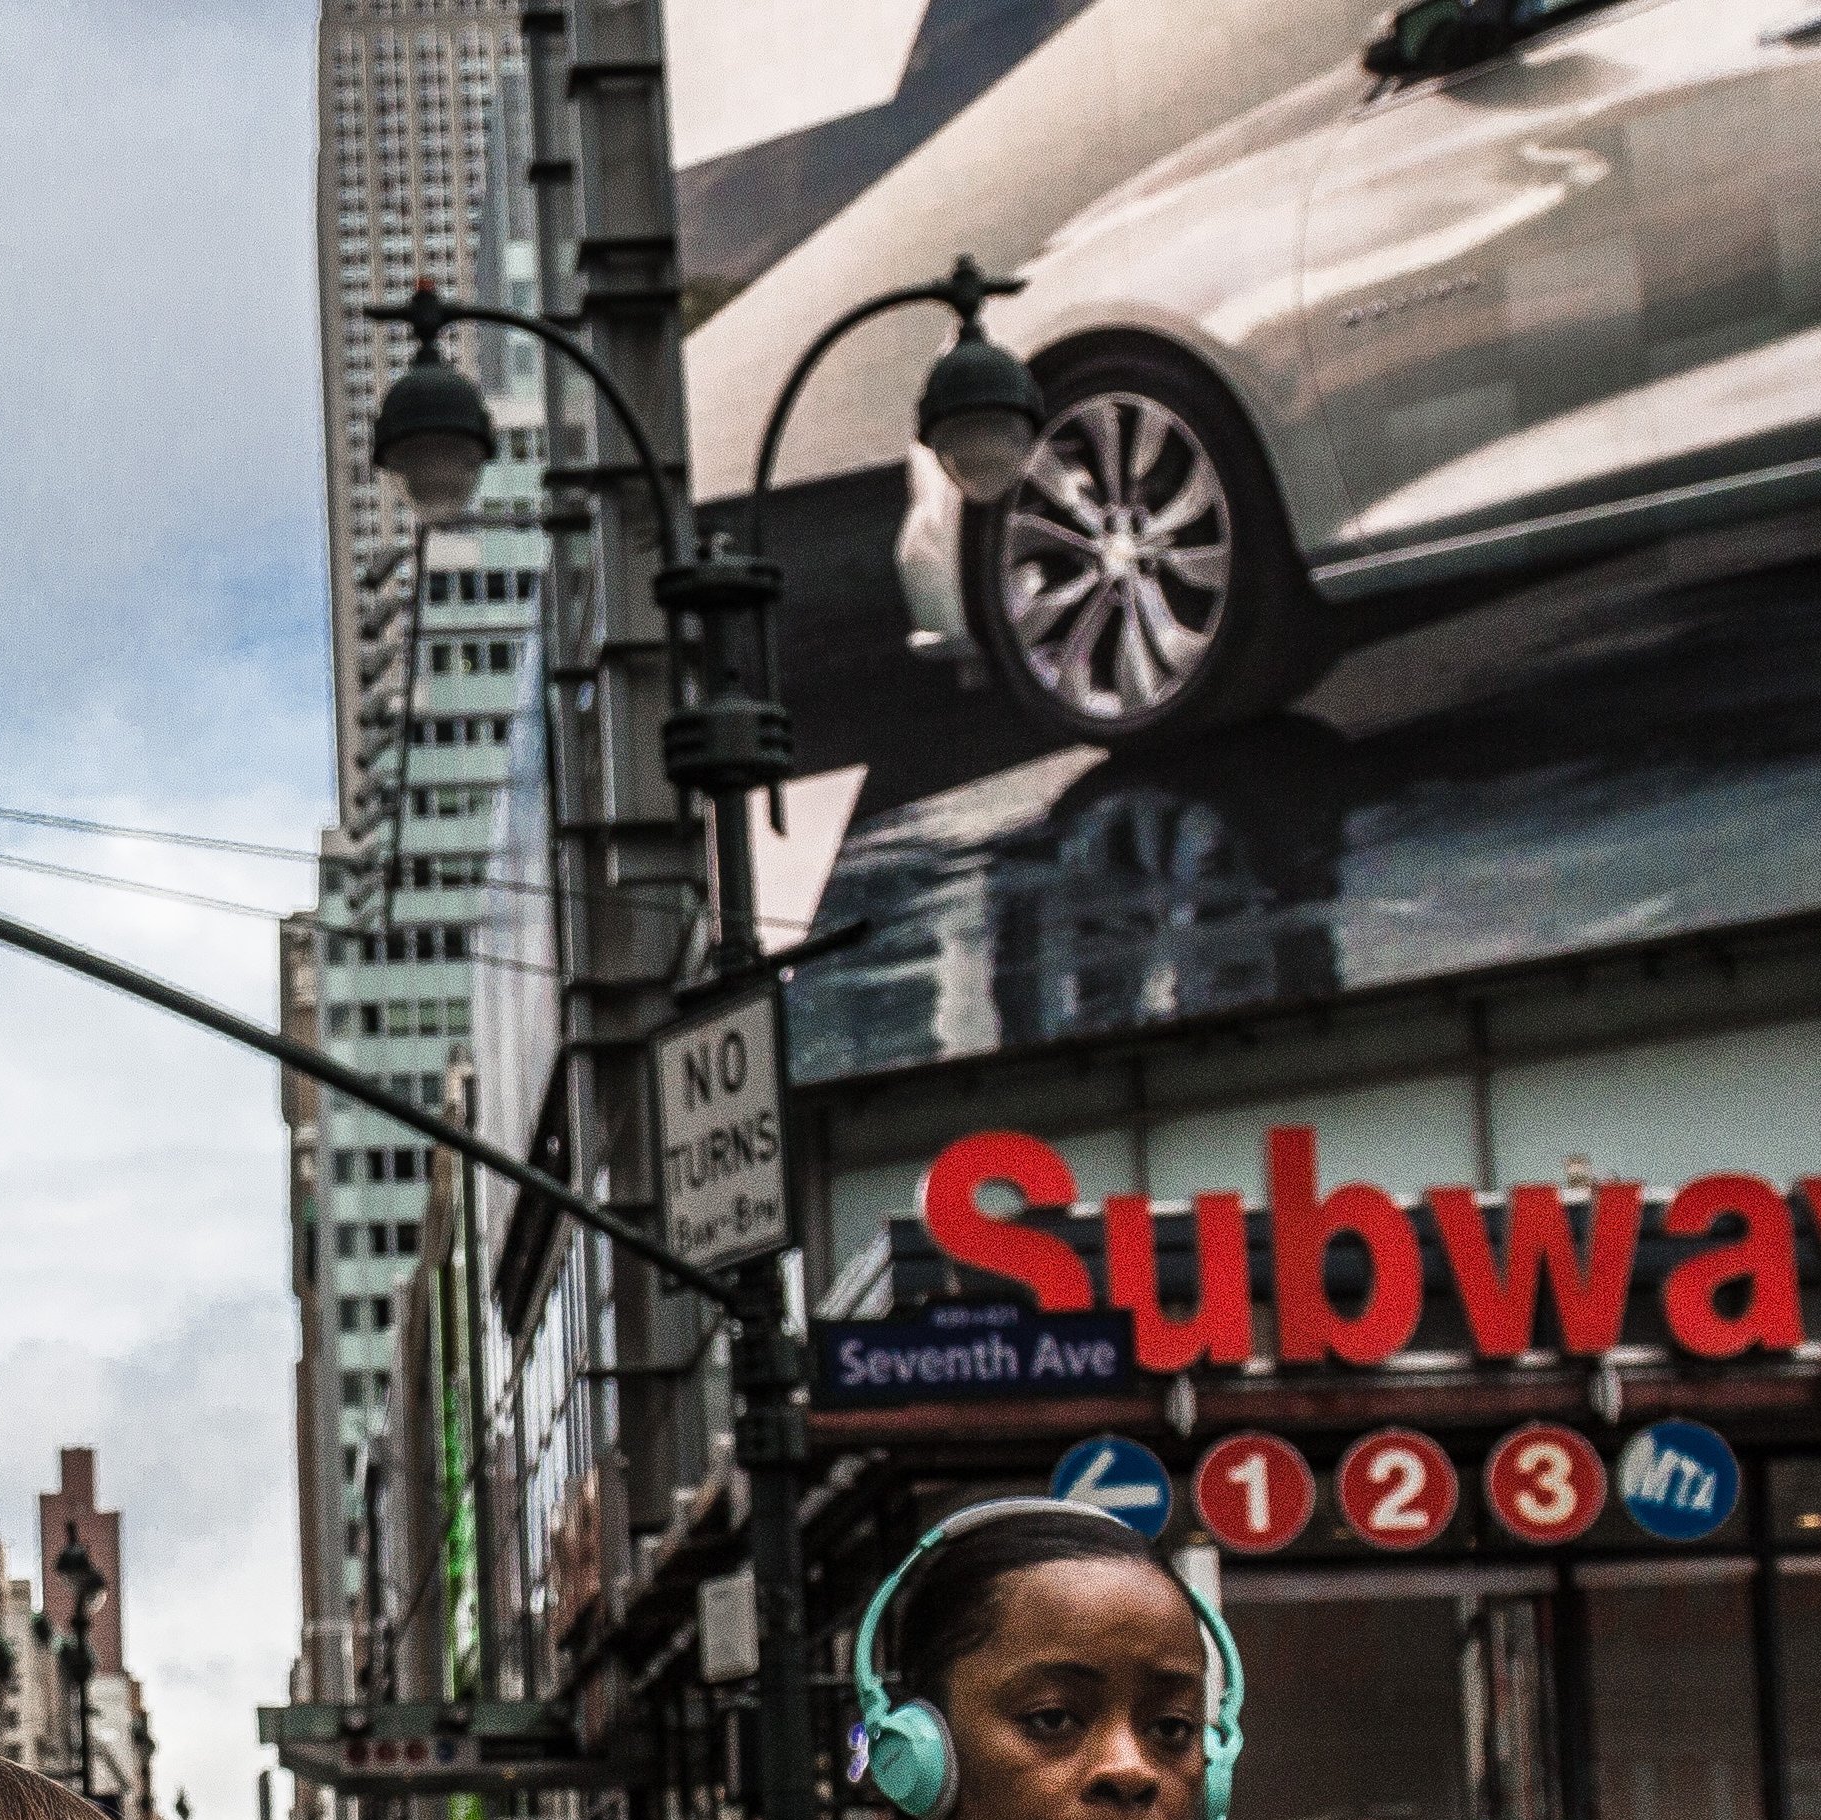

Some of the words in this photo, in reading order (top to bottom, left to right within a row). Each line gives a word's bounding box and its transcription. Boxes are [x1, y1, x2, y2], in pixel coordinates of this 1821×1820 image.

[683, 1030, 747, 1112] NO
[664, 1110, 779, 1196] TURNS
[917, 1125, 1821, 1372] Subwa
[838, 1334, 1019, 1386] Seventh
[1031, 1332, 1118, 1377] Ave
[1227, 1455, 1270, 1532] 1
[1366, 1449, 1430, 1530] 2
[1512, 1443, 1576, 1525] 3
